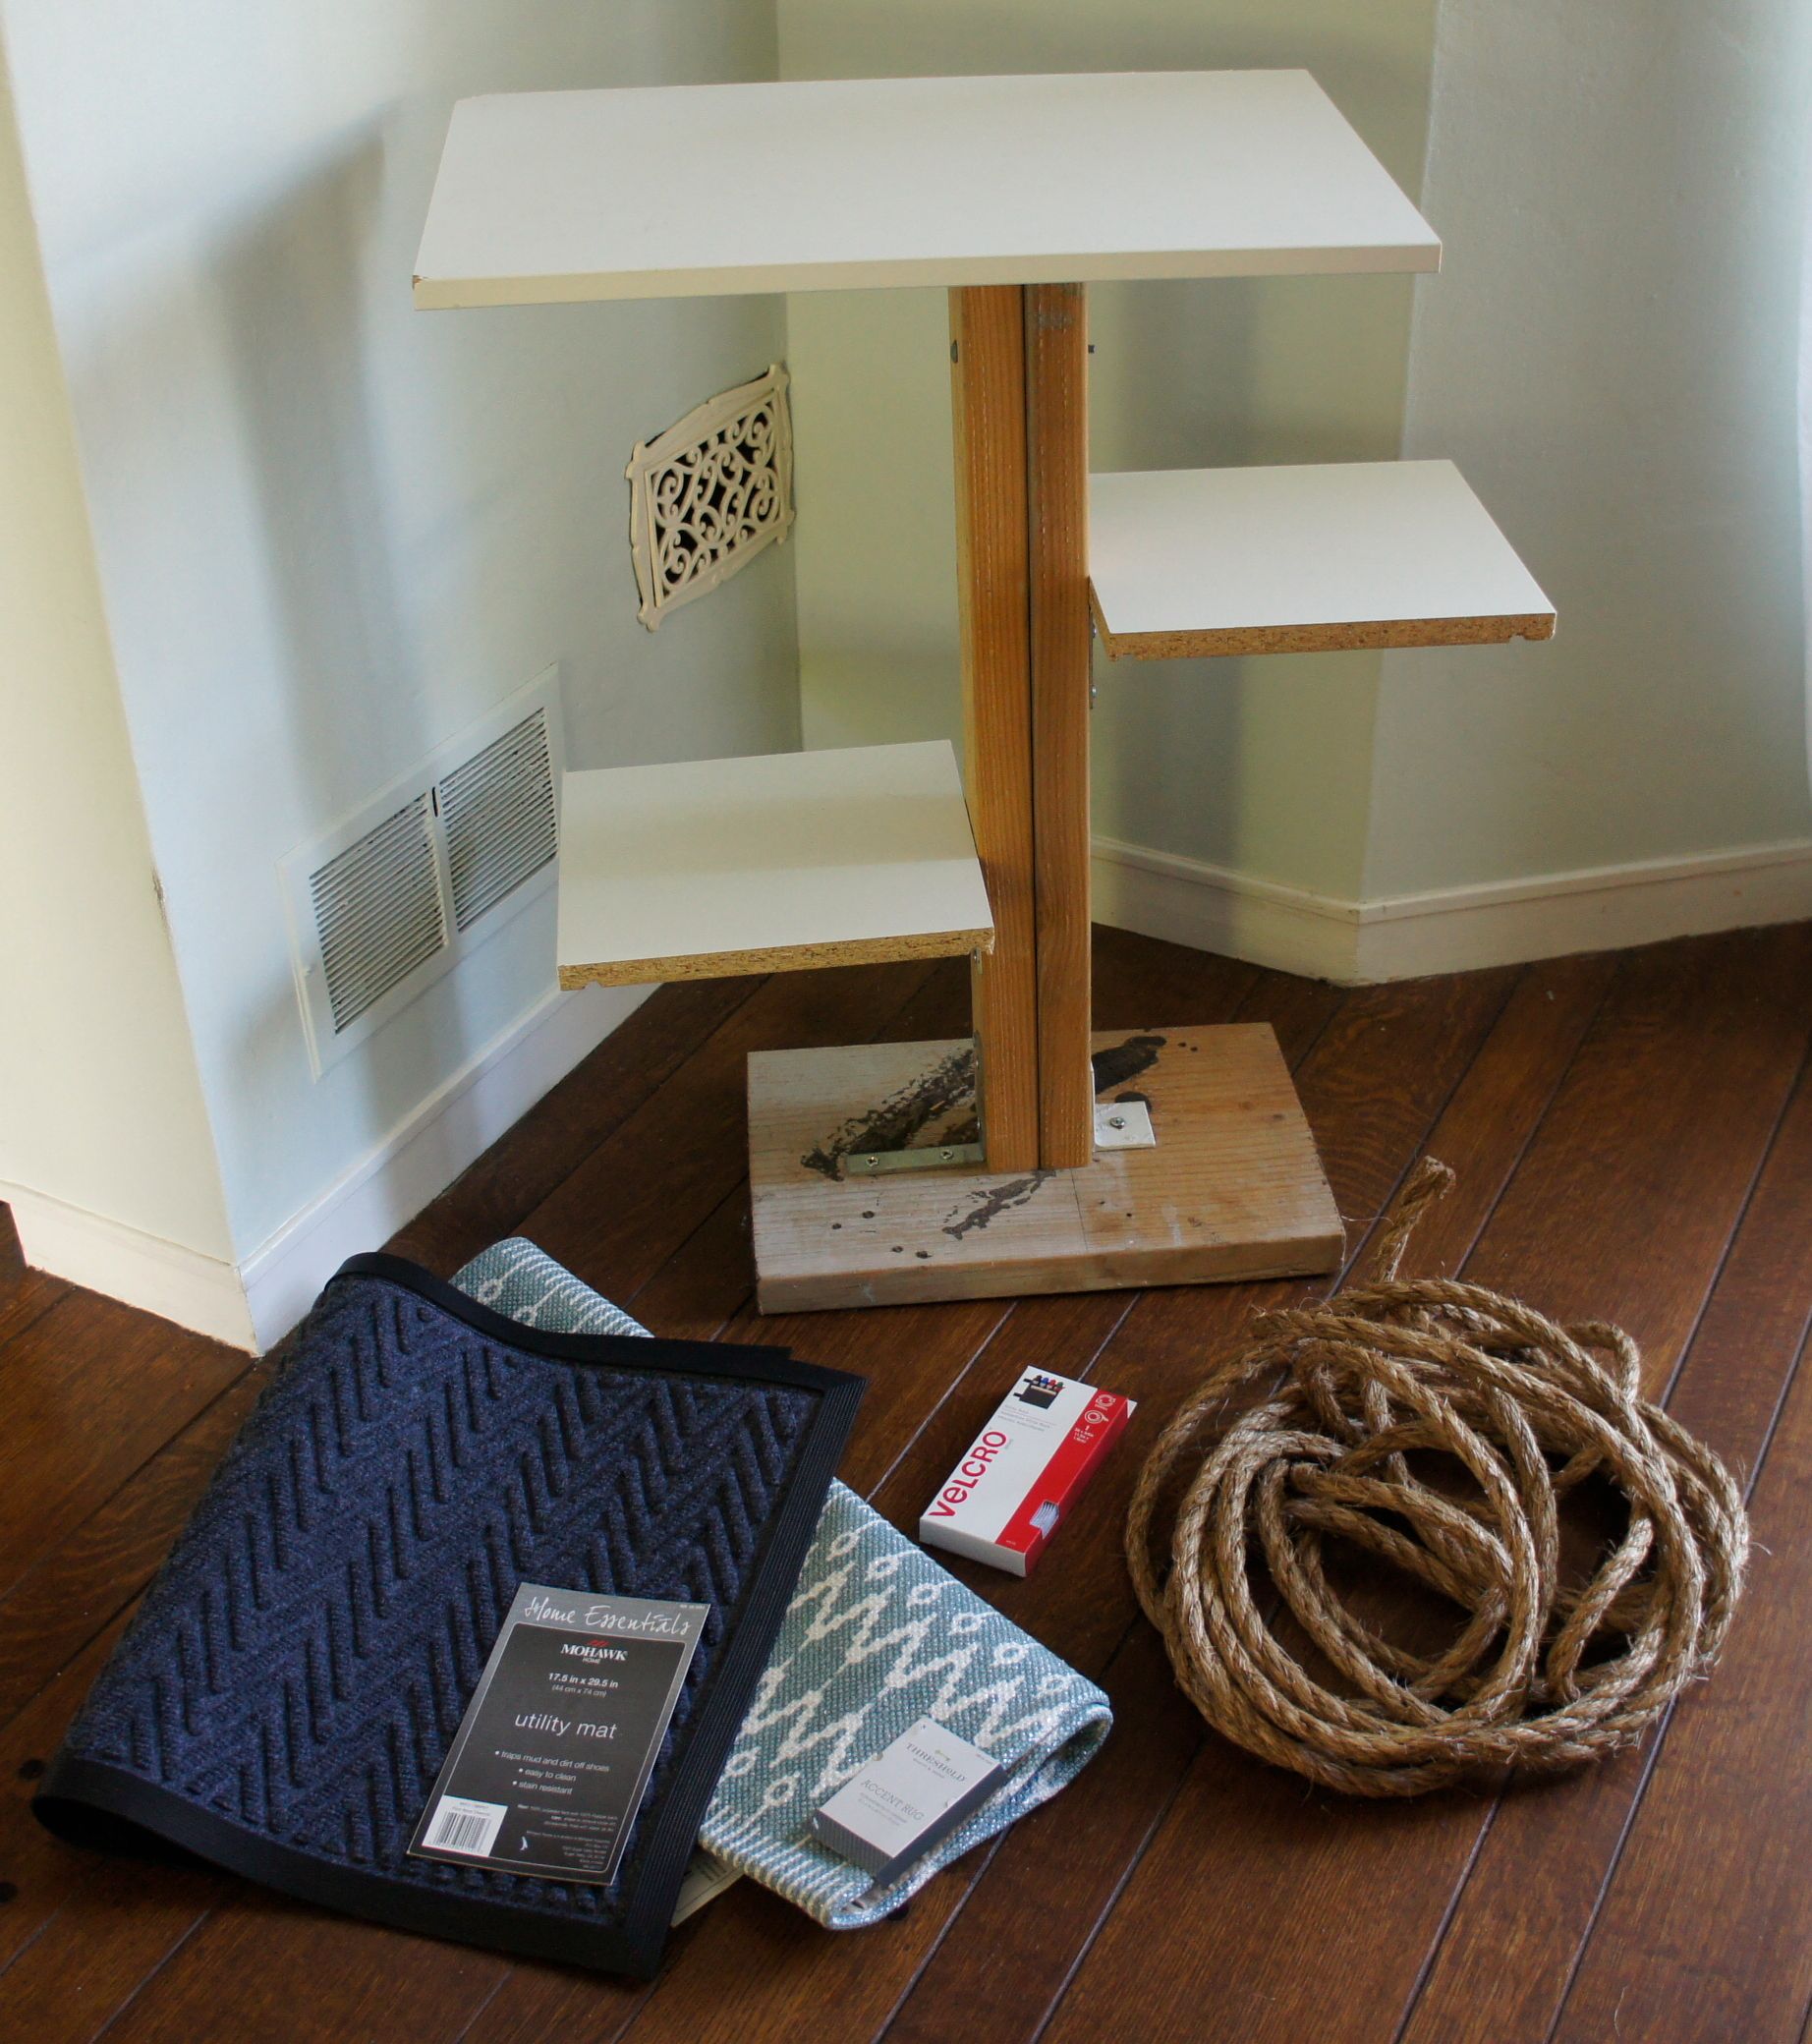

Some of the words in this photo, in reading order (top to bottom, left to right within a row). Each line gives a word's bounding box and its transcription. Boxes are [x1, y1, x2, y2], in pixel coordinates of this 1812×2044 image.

[525, 1596, 575, 1624] Home
[585, 1605, 692, 1636] Essentials
[548, 1673, 568, 1682] 17.5
[570, 1675, 579, 1683] in
[609, 1679, 619, 1688] in
[515, 1713, 571, 1737] utility
[576, 1721, 618, 1739] mat
[501, 1751, 522, 1762] traps
[523, 1755, 542, 1764] mud
[542, 1757, 558, 1766] and
[586, 1762, 610, 1773] shoes
[905, 1742, 967, 1784] THRESHOLD
[525, 1769, 543, 1780] easy
[554, 1773, 577, 1782] clean
[519, 1781, 538, 1789] stain
[538, 1785, 573, 1795] resistant
[861, 1779, 906, 1809] ACCENT
[902, 1803, 926, 1821] RUG
